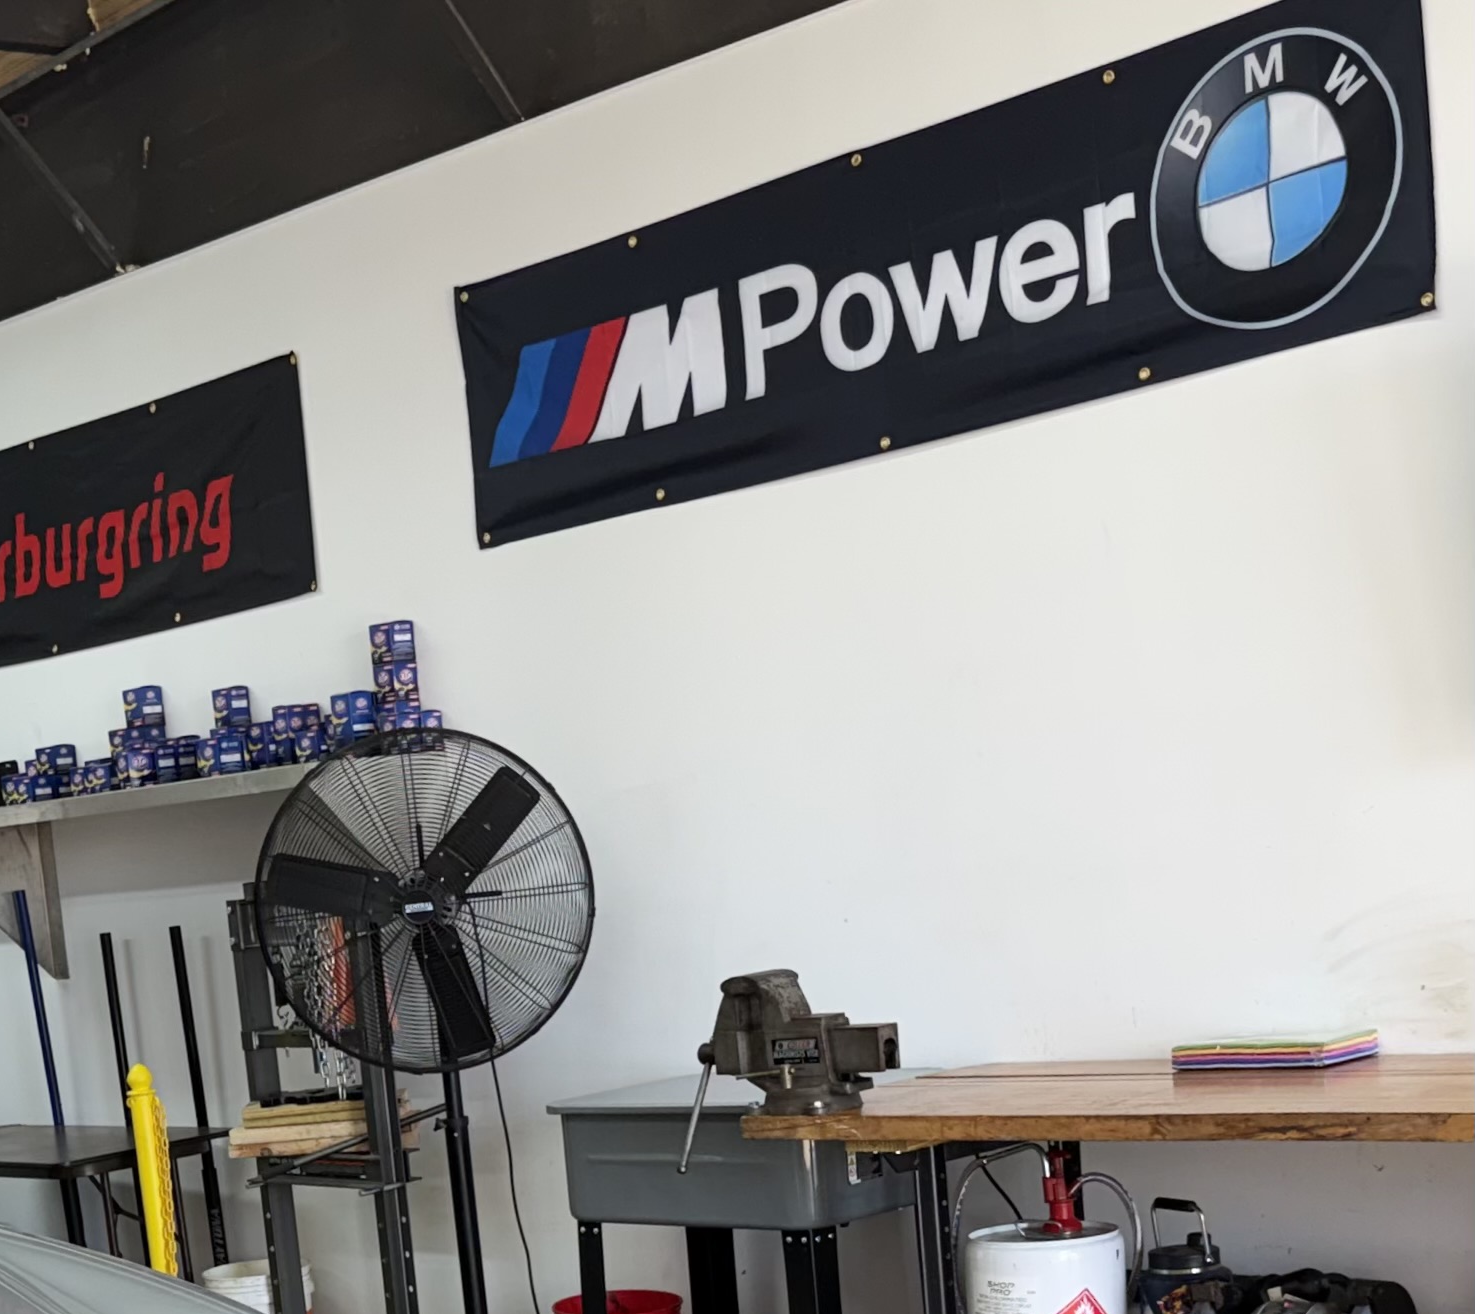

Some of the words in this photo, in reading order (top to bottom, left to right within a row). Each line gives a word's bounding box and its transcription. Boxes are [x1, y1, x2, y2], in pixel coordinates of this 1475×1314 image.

[1169, 42, 1368, 160] BMW
[738, 192, 1136, 401] Power
[987, 1280, 1015, 1289] SHOP
[990, 1288, 1011, 1296] PRO
